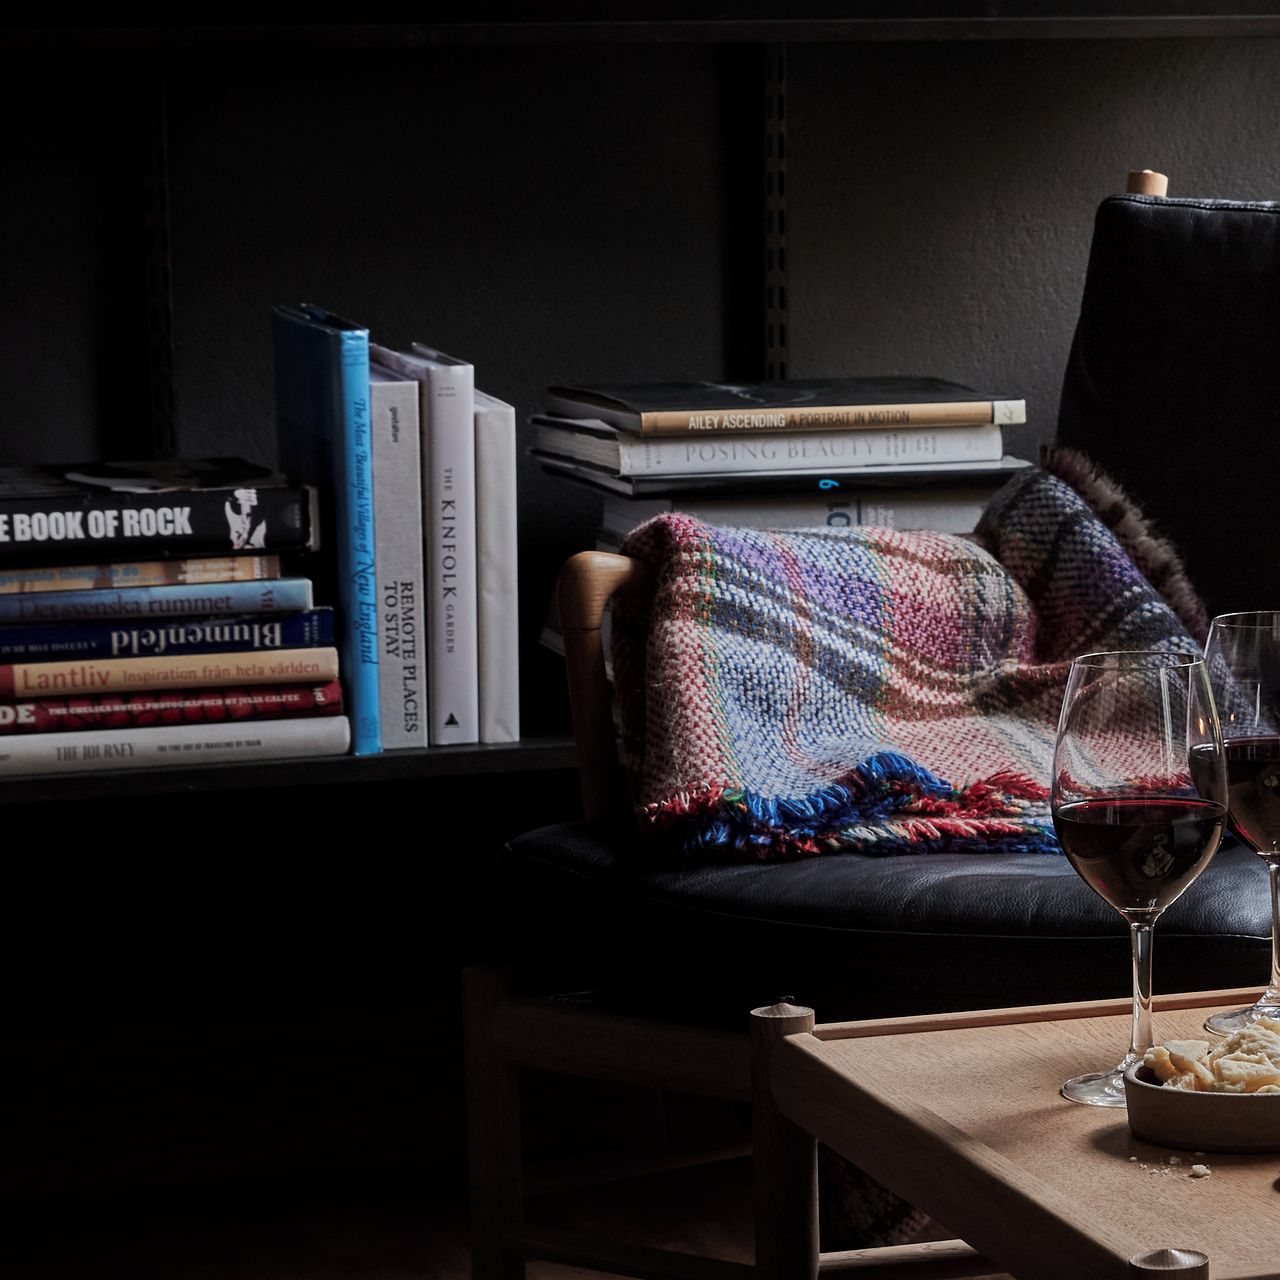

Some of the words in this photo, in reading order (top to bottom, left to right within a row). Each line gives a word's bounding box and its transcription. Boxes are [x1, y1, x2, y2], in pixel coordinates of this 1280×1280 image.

[353, 399, 366, 419] The
[389, 406, 400, 444] gestalten
[689, 415, 719, 430] AILEY
[722, 414, 786, 429] ASCENDING
[787, 414, 797, 427] A
[799, 412, 851, 426] PORTRAIT
[855, 412, 866, 425] IN
[869, 411, 910, 424] MOTION
[354, 423, 367, 447] Most
[685, 440, 776, 463] POSING
[787, 437, 874, 459] BEAUTY
[352, 451, 369, 501] Beautiful
[444, 468, 453, 491] THE
[12, 510, 85, 542] BOOK
[87, 508, 119, 539] OF
[122, 506, 193, 538] ROCK
[354, 503, 369, 541] Villages
[442, 499, 457, 599] KINFOLK
[357, 558, 376, 598] New
[385, 582, 398, 608] TO
[63, 594, 141, 616] svenska
[148, 594, 234, 613] rummet
[400, 581, 415, 659] REMOTE
[110, 623, 283, 657] Blumenfeld
[353, 600, 377, 665] England
[385, 613, 399, 658] STAY
[444, 604, 455, 654] GARDEN
[23, 665, 110, 690] Lantliv
[123, 669, 196, 686] Inspiration
[202, 664, 231, 683] från
[235, 663, 265, 677] hela
[269, 662, 320, 677] världen
[48, 706, 68, 716] THE
[402, 666, 418, 733] PLACES
[56, 746, 80, 762] THE
[82, 743, 135, 761] JOURNEY
